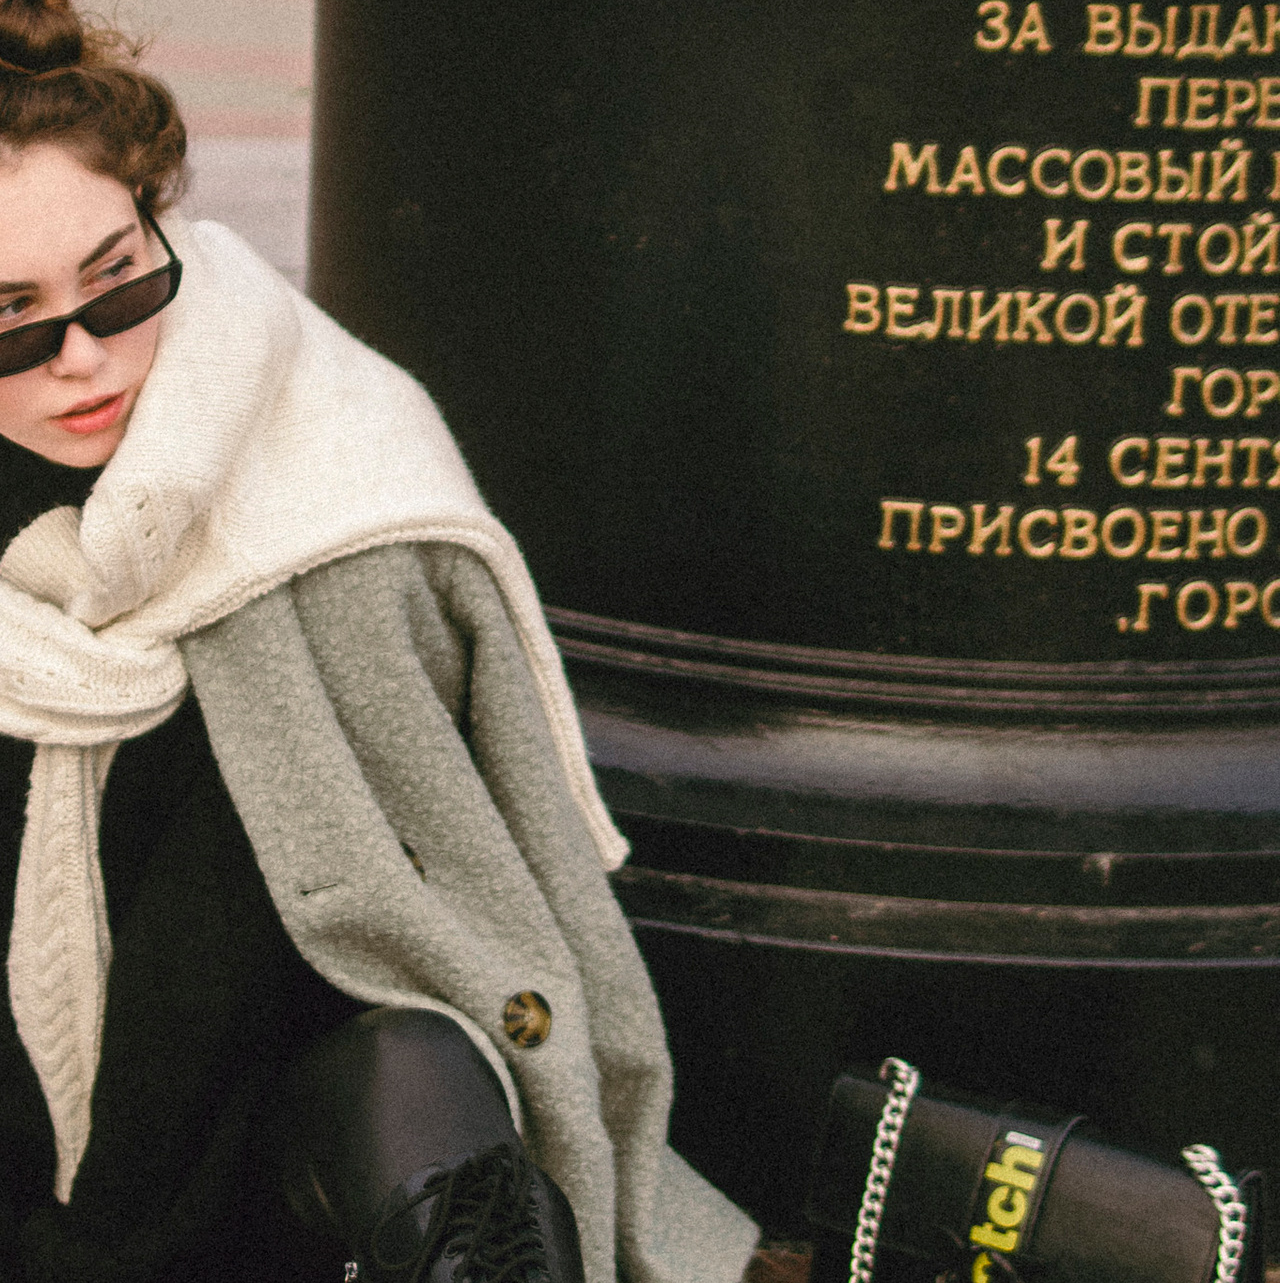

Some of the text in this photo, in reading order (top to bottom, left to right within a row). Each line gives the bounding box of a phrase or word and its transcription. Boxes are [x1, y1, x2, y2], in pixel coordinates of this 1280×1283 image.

[975, 0, 1052, 52] ЗА
[883, 138, 1252, 202] МАССОВЫЙ
[1040, 212, 1280, 275] И СТОЙ
[843, 283, 1280, 347] ВЕЛИКОЙ ОТЕ
[1166, 366, 1280, 418] ГОР
[1023, 435, 1081, 486] 14
[878, 499, 1267, 561] ПРИСВОЕНО
